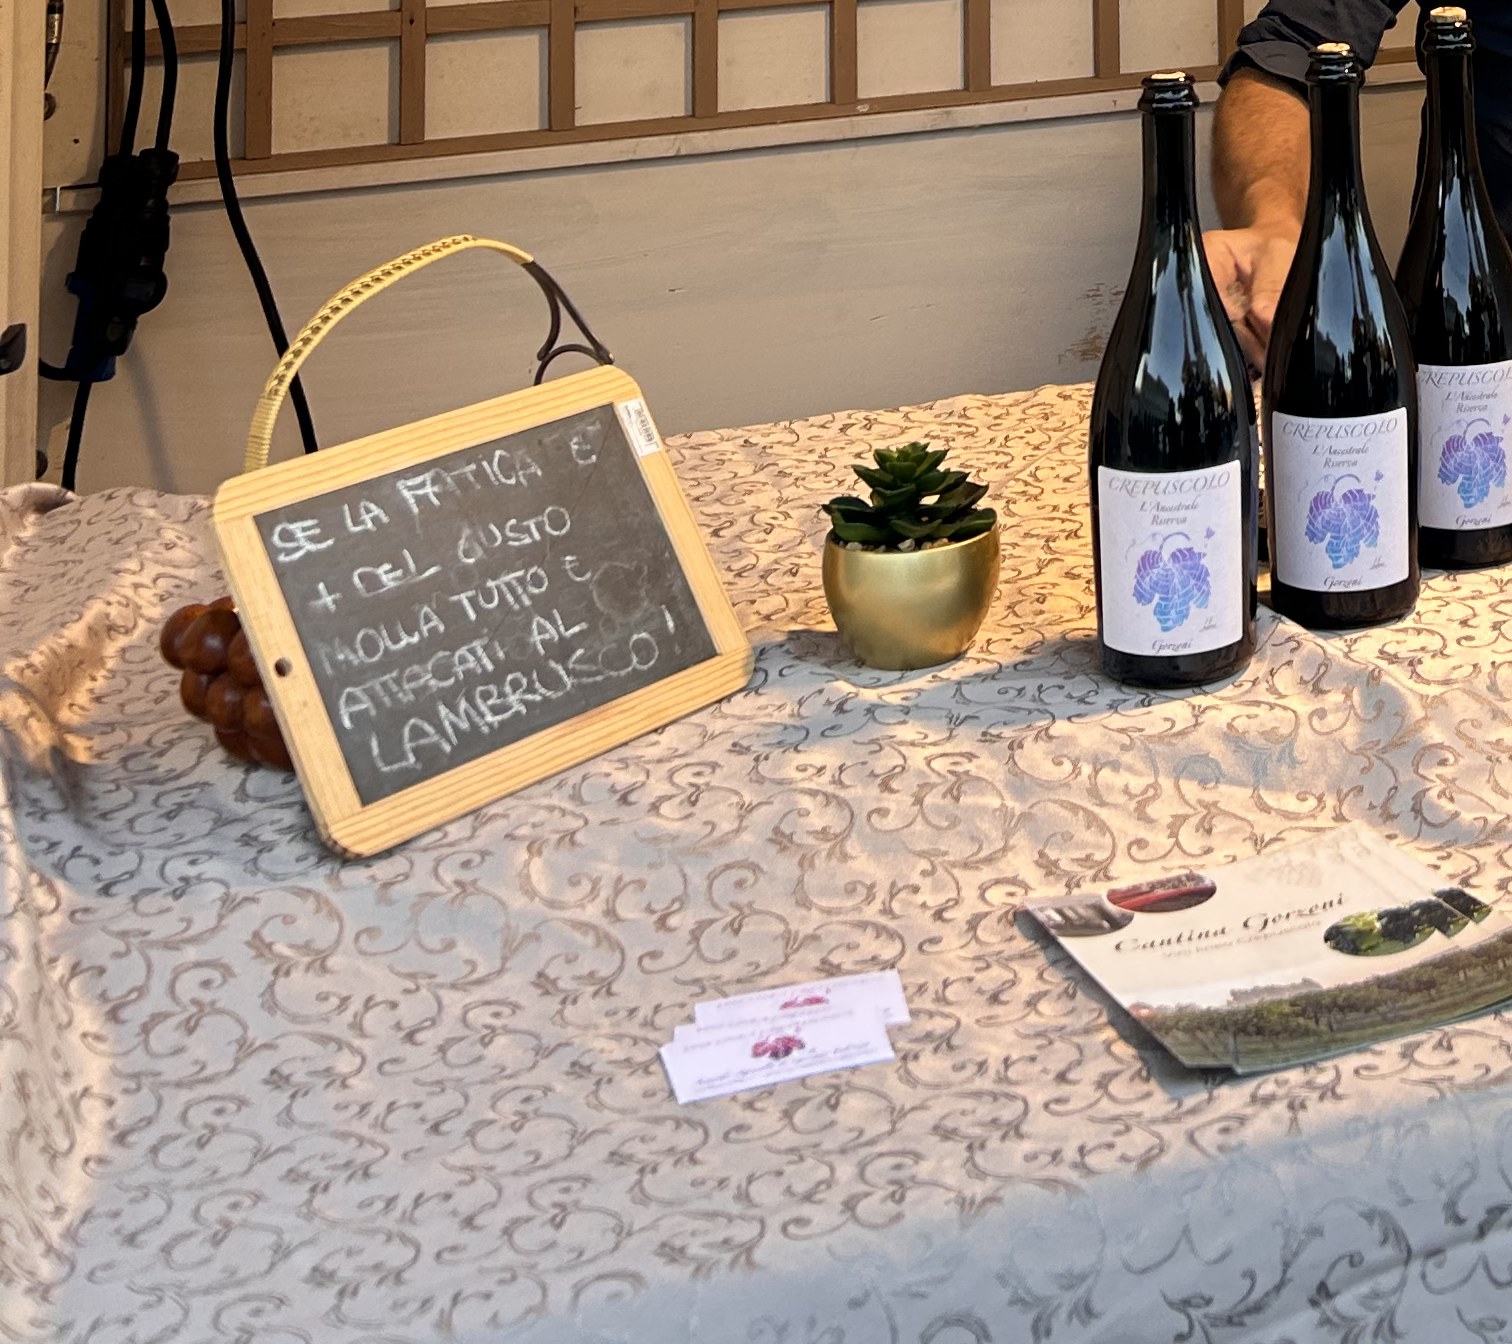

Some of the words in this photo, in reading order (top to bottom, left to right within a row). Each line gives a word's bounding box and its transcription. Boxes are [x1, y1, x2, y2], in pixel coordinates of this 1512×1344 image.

[1282, 418, 1398, 440] CREPUSCOLO
[1109, 471, 1230, 497] CREPUSCOLO
[271, 518, 335, 562] SE
[343, 500, 391, 534] LA
[309, 581, 342, 613] +
[352, 549, 442, 598] DEL
[457, 506, 571, 565] GUSTO
[320, 606, 446, 678] MOLLA
[449, 565, 550, 621] TUTTO
[530, 608, 589, 655] AL
[1115, 927, 1226, 952] Cantina
[1243, 891, 1344, 932] Gorzoni
